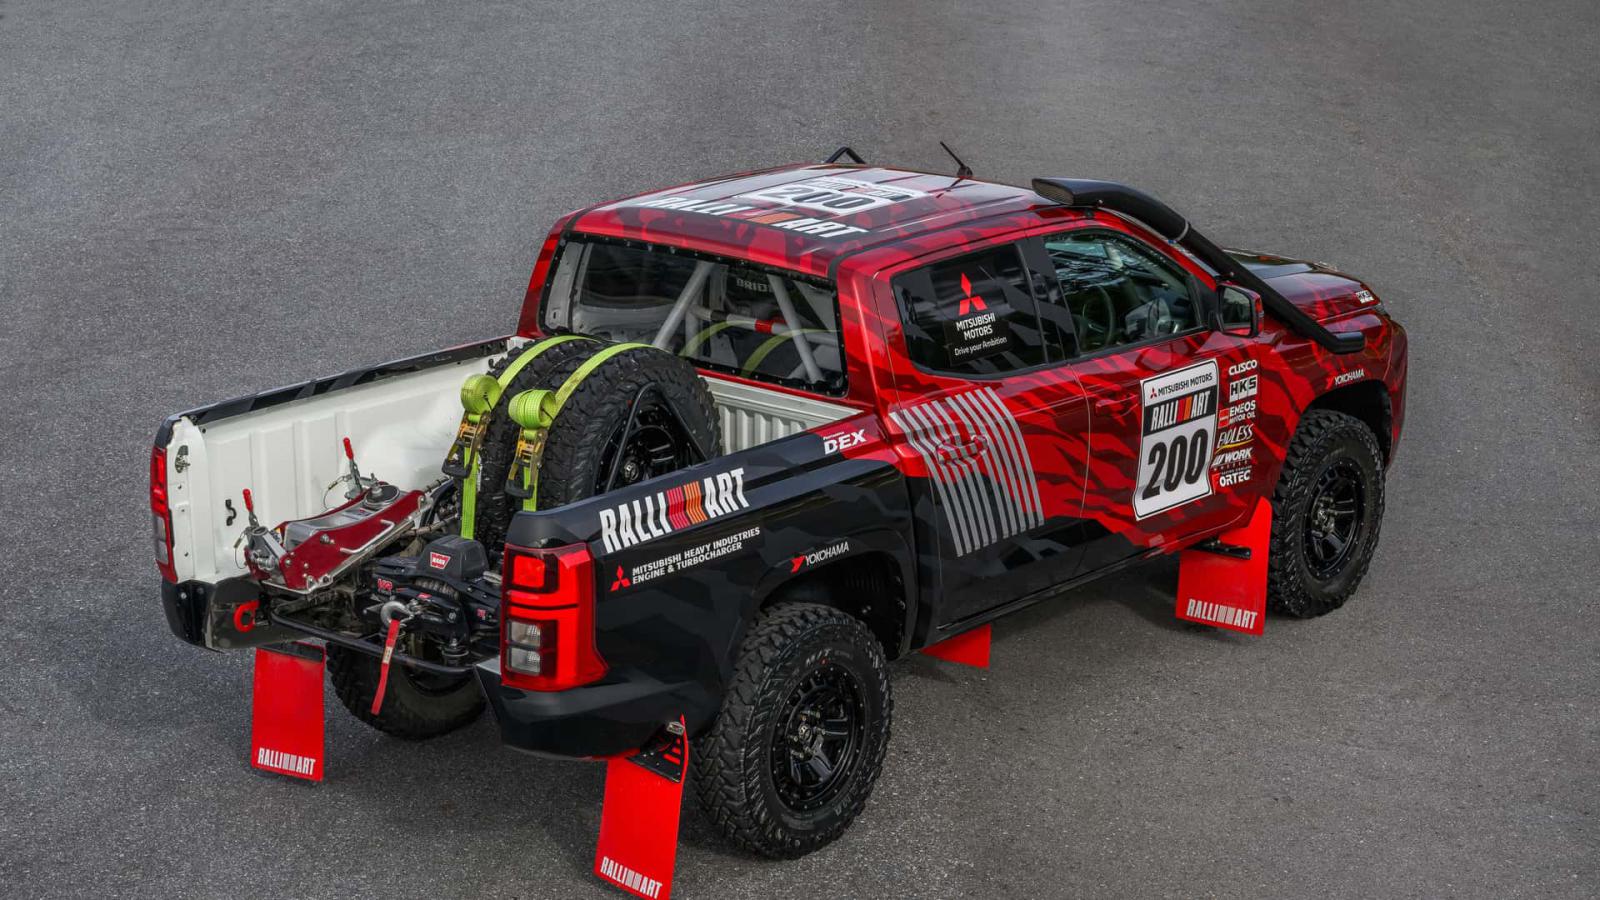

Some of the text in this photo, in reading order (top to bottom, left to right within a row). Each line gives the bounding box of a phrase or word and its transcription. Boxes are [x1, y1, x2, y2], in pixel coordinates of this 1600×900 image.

[758, 184, 876, 212] 200
[955, 312, 996, 331] MITSUBISHI
[963, 324, 993, 341] MOTORS
[954, 336, 1008, 356] Drive your Ambition
[1229, 359, 1258, 376] CUSCO
[1334, 368, 1365, 386] YOKOHAMA
[1157, 372, 1213, 396] MITSUBISHI MOTORS
[1229, 375, 1257, 399] HKS
[1229, 411, 1256, 425] MOTOR OIL
[1230, 400, 1256, 417] ENEOS
[823, 429, 867, 455] DEX
[1216, 424, 1254, 449] ENDLESS
[1142, 428, 1209, 500] 200
[1224, 447, 1253, 463] WORK
[632, 527, 761, 577] MITSUBISHI HEAVY INDUSTRIES
[632, 542, 743, 585] ENGINE & TURBOCHARGER
[805, 541, 849, 566] YOKOHAMA
